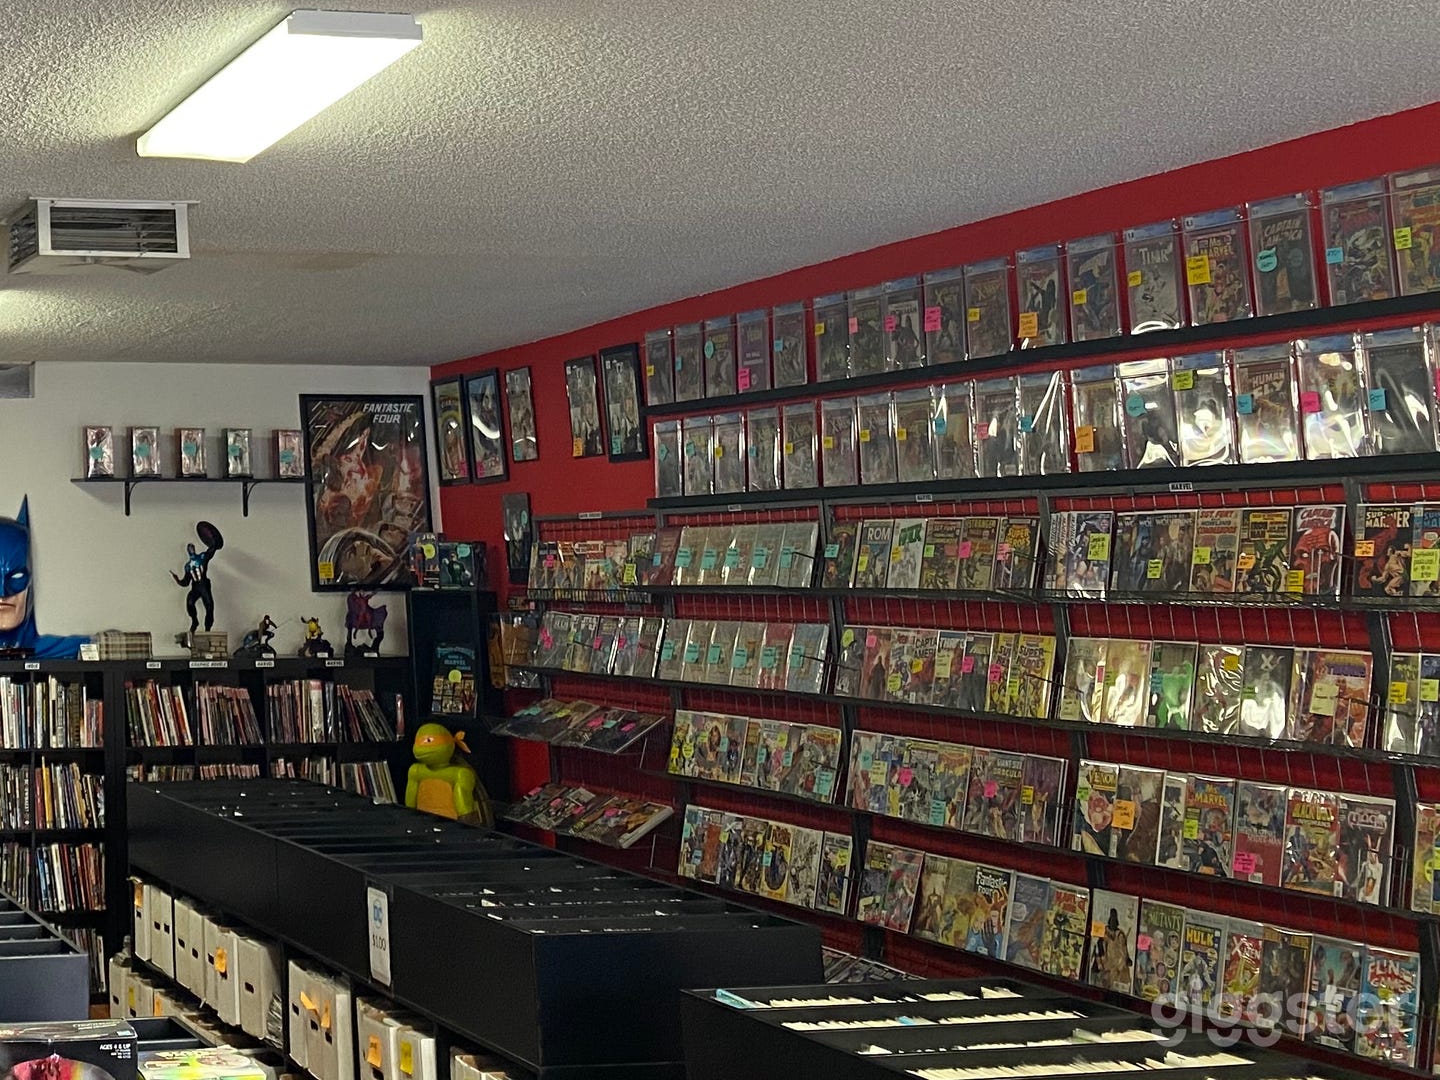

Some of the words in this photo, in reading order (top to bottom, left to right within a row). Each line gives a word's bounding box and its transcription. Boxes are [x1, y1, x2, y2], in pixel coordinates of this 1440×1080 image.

[1253, 373, 1285, 389] HUMAN
[363, 403, 414, 413] FANTASTIC
[373, 414, 400, 424] FOUR
[868, 528, 891, 540] ROM
[1195, 792, 1228, 807] MARVEL
[372, 934, 387, 951] $1.00
[1186, 926, 1215, 945] HULK
